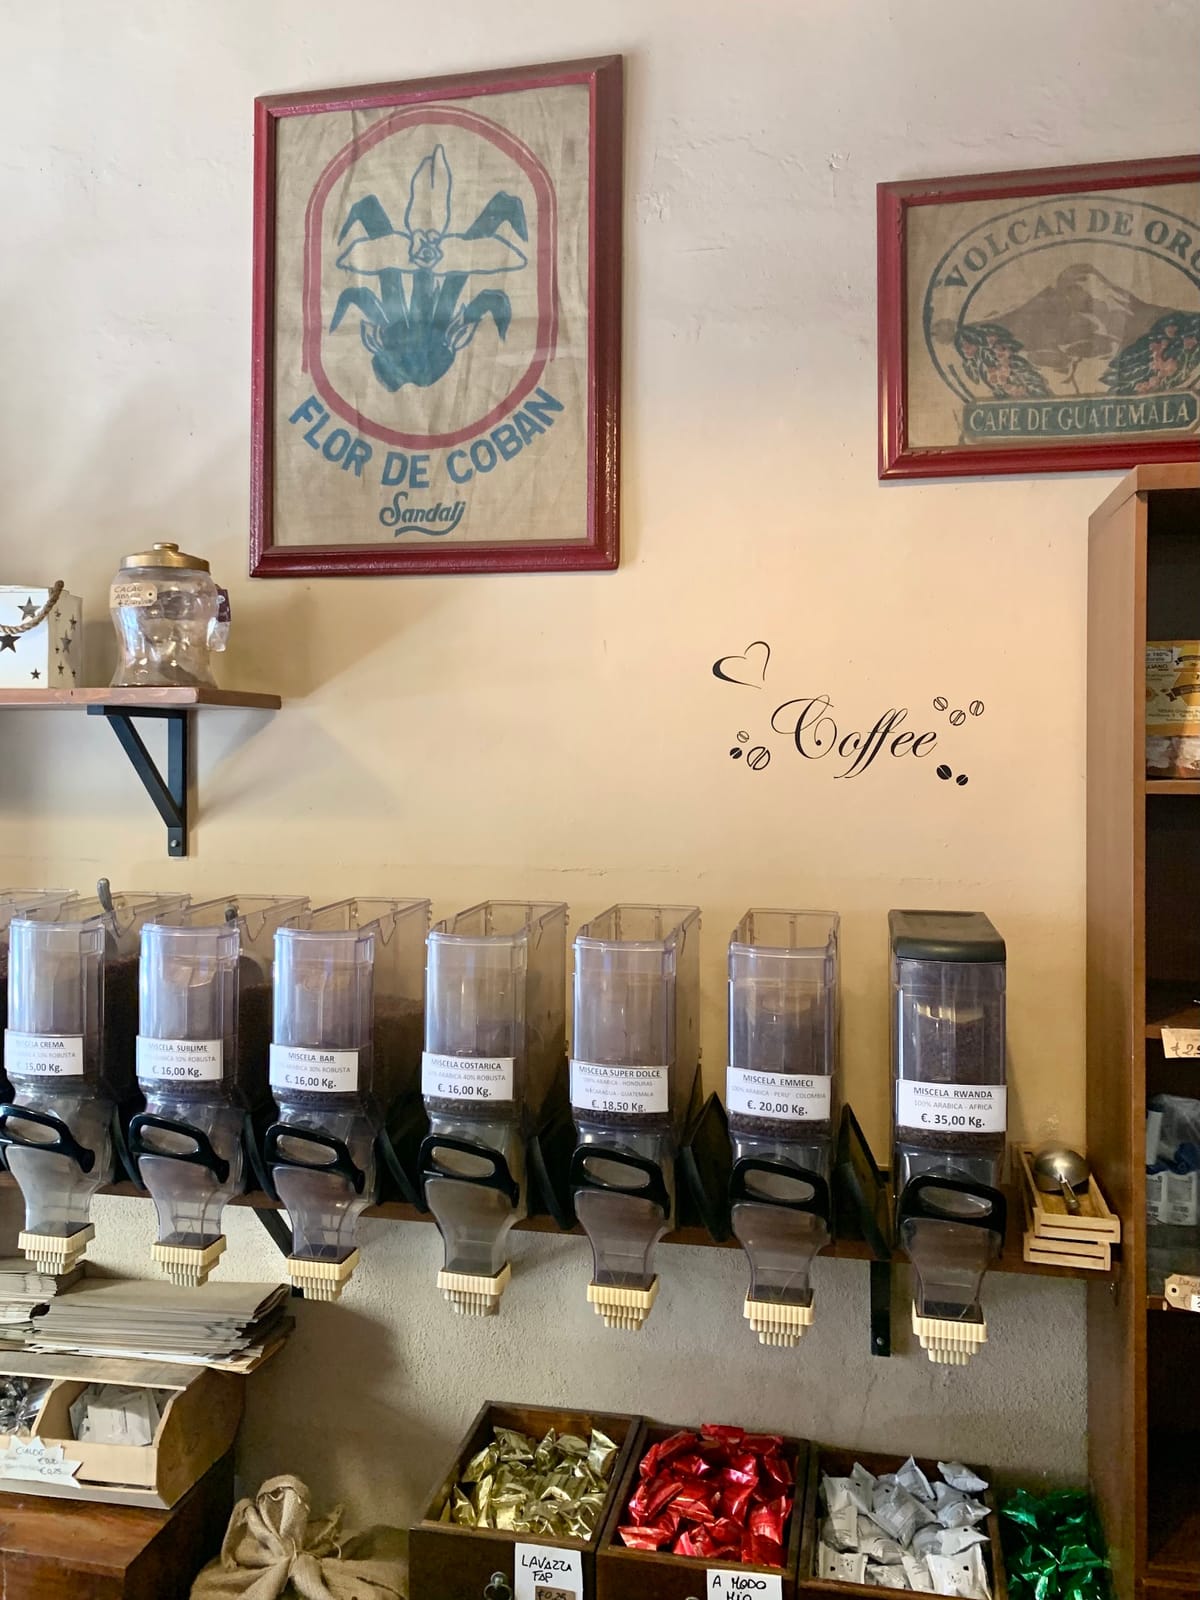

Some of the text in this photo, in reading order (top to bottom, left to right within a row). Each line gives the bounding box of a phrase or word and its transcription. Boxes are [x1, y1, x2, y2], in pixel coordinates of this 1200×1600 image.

[944, 208, 1076, 288] VOLCAN
[1087, 208, 1134, 236] DE
[970, 408, 1021, 432] CAFE
[1057, 400, 1190, 431] GUATEMALA
[288, 387, 565, 488] FLOR DE COBAN
[379, 491, 467, 537] Sandalj
[771, 694, 938, 779] Coffee
[40, 1041, 65, 1049] CREMA
[177, 1045, 208, 1053] SUBLIME
[288, 1052, 317, 1061] MISCELA
[49, 1063, 63, 1073] Kg.
[432, 1059, 502, 1070] MISCELA COSTARICA
[579, 1065, 608, 1076] MISCELA
[161, 1066, 186, 1076] 16,00
[187, 1067, 203, 1078] Kg.
[295, 1076, 320, 1087] 16,00
[321, 1078, 337, 1089] Kg.
[743, 1074, 814, 1087] MISCELA EMMECI
[448, 1084, 474, 1096] 16,00
[476, 1086, 492, 1098] Kg.
[913, 1087, 993, 1099] MISCELA RWANDA
[602, 1100, 629, 1112] 18,50
[631, 1102, 647, 1113] Kg.
[747, 1100, 808, 1116] €. 20,00 Kg.
[933, 1102, 963, 1110] ARABICA
[921, 1113, 986, 1128] €. 35,00 Kg.
[521, 1554, 572, 1571] LAVAZZA
[532, 1570, 553, 1583] FAP
[712, 1574, 767, 1590] A MODO
